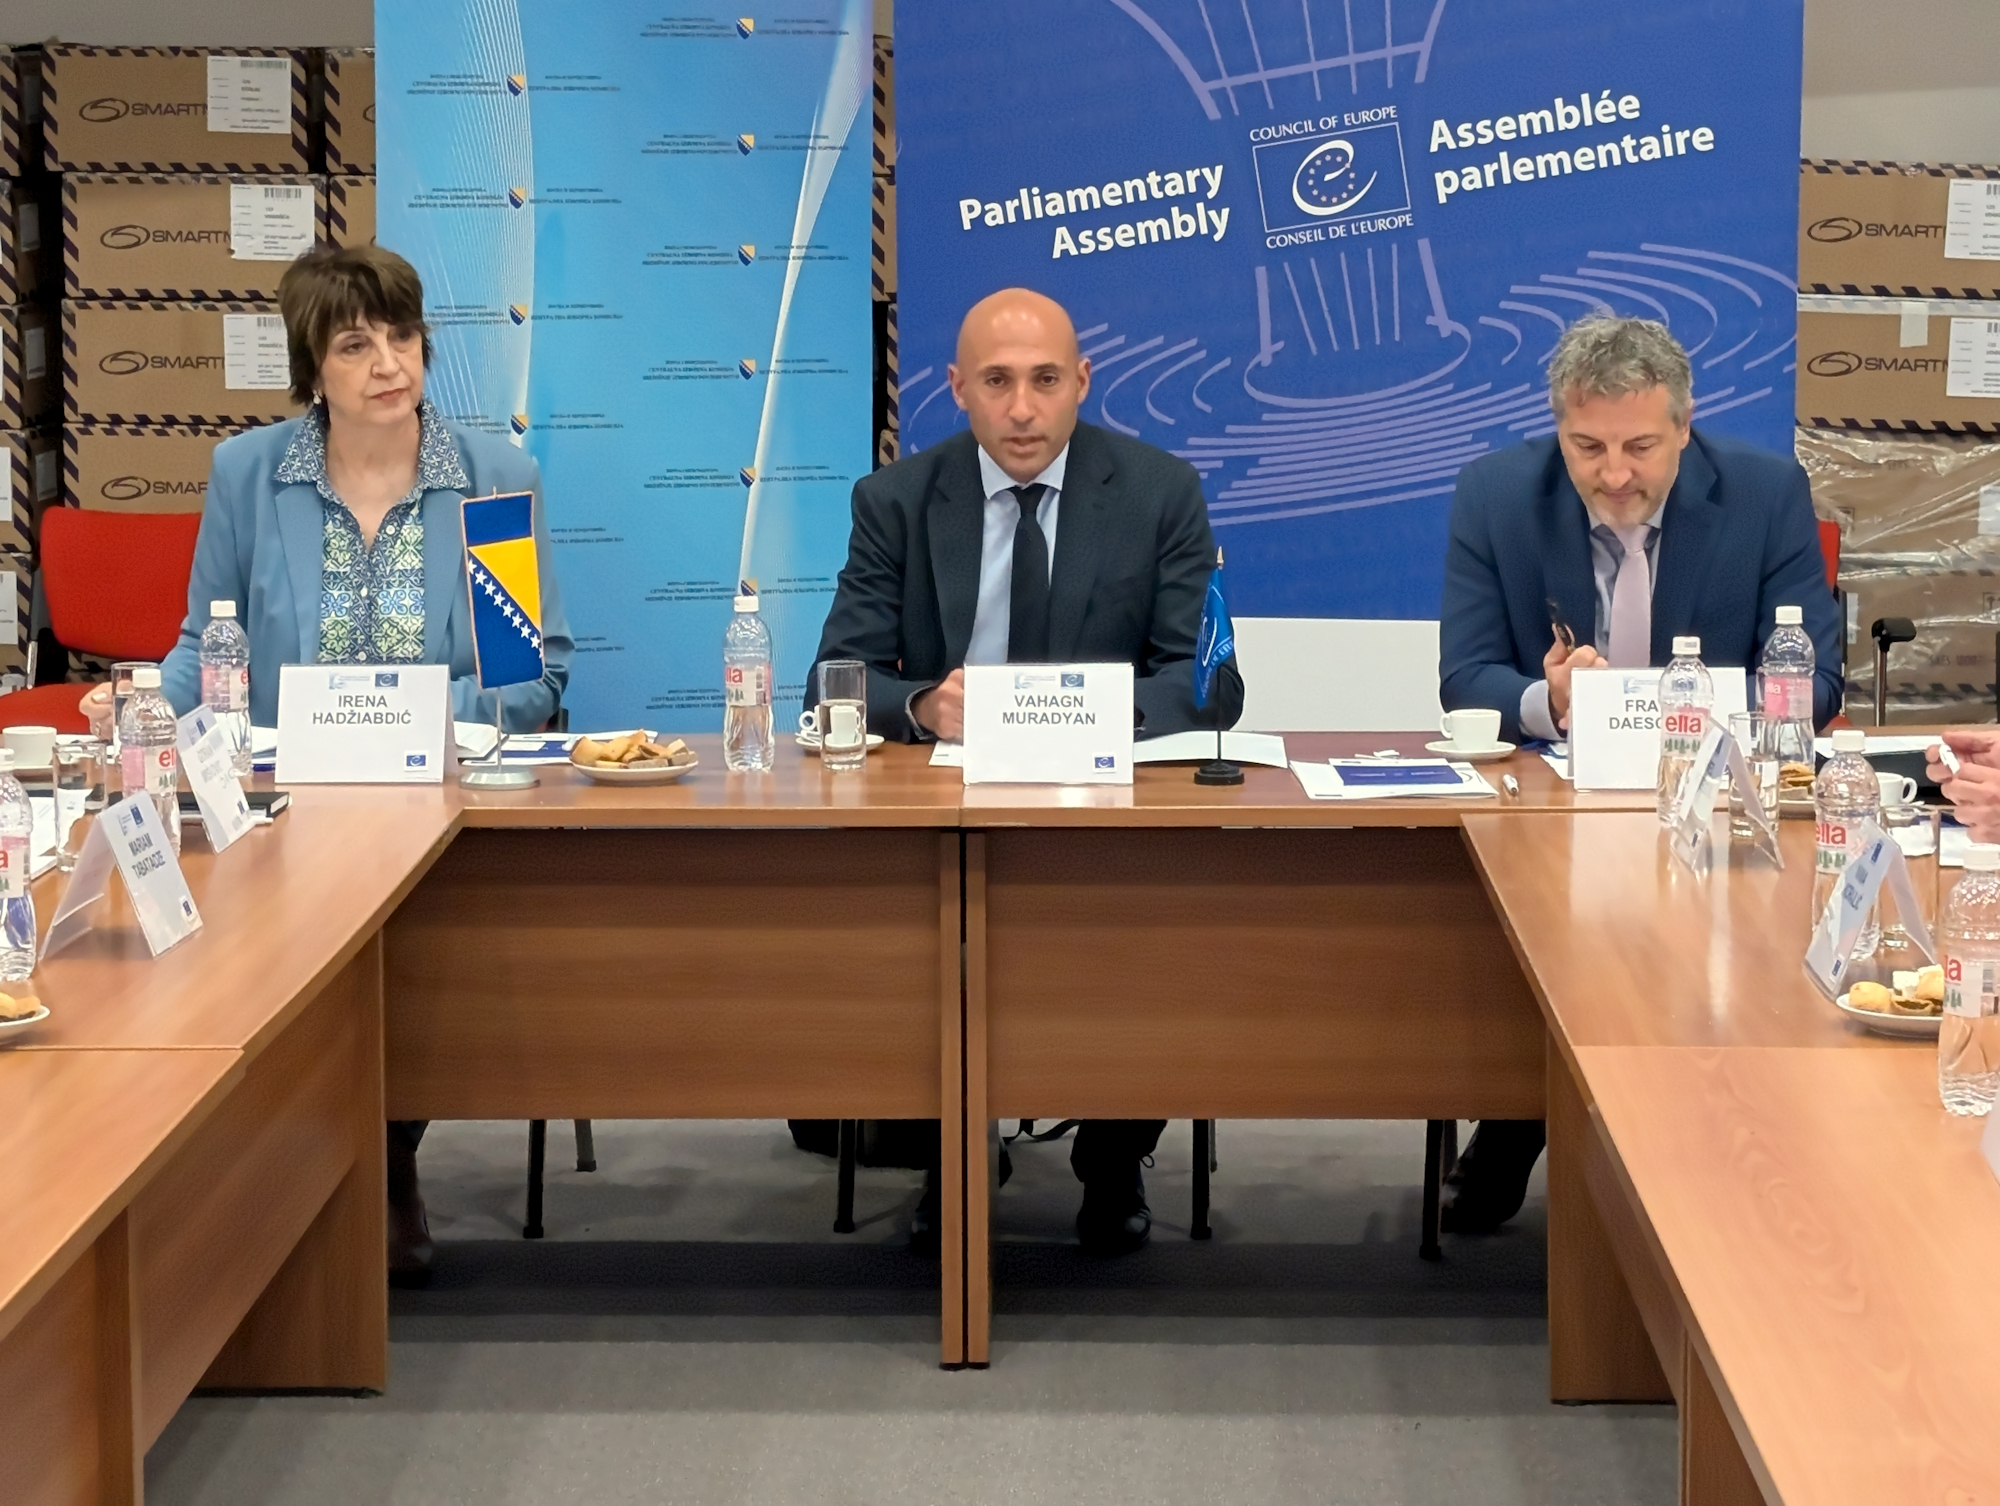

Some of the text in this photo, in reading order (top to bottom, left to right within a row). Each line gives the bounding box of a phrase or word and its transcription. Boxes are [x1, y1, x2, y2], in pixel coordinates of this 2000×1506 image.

[1250, 105, 1398, 142] COUNCIL OF EUROPE
[1429, 89, 1641, 153] Assemblée
[1434, 124, 1715, 204] parlementaire
[959, 165, 1223, 231] Parliamentary
[1052, 202, 1230, 259] Assembly
[1266, 213, 1414, 249] CONSEIL DE L'EUROPE
[1865, 223, 1946, 238] SMART
[151, 356, 225, 369] SMART
[338, 695, 388, 707] IRENA
[1014, 695, 1084, 708] VAHAGN
[1625, 699, 1659, 712] FRA
[312, 709, 412, 725] HADŽIABDIĆ
[1002, 711, 1096, 725] MURADYAN
[1665, 714, 1701, 734] ella
